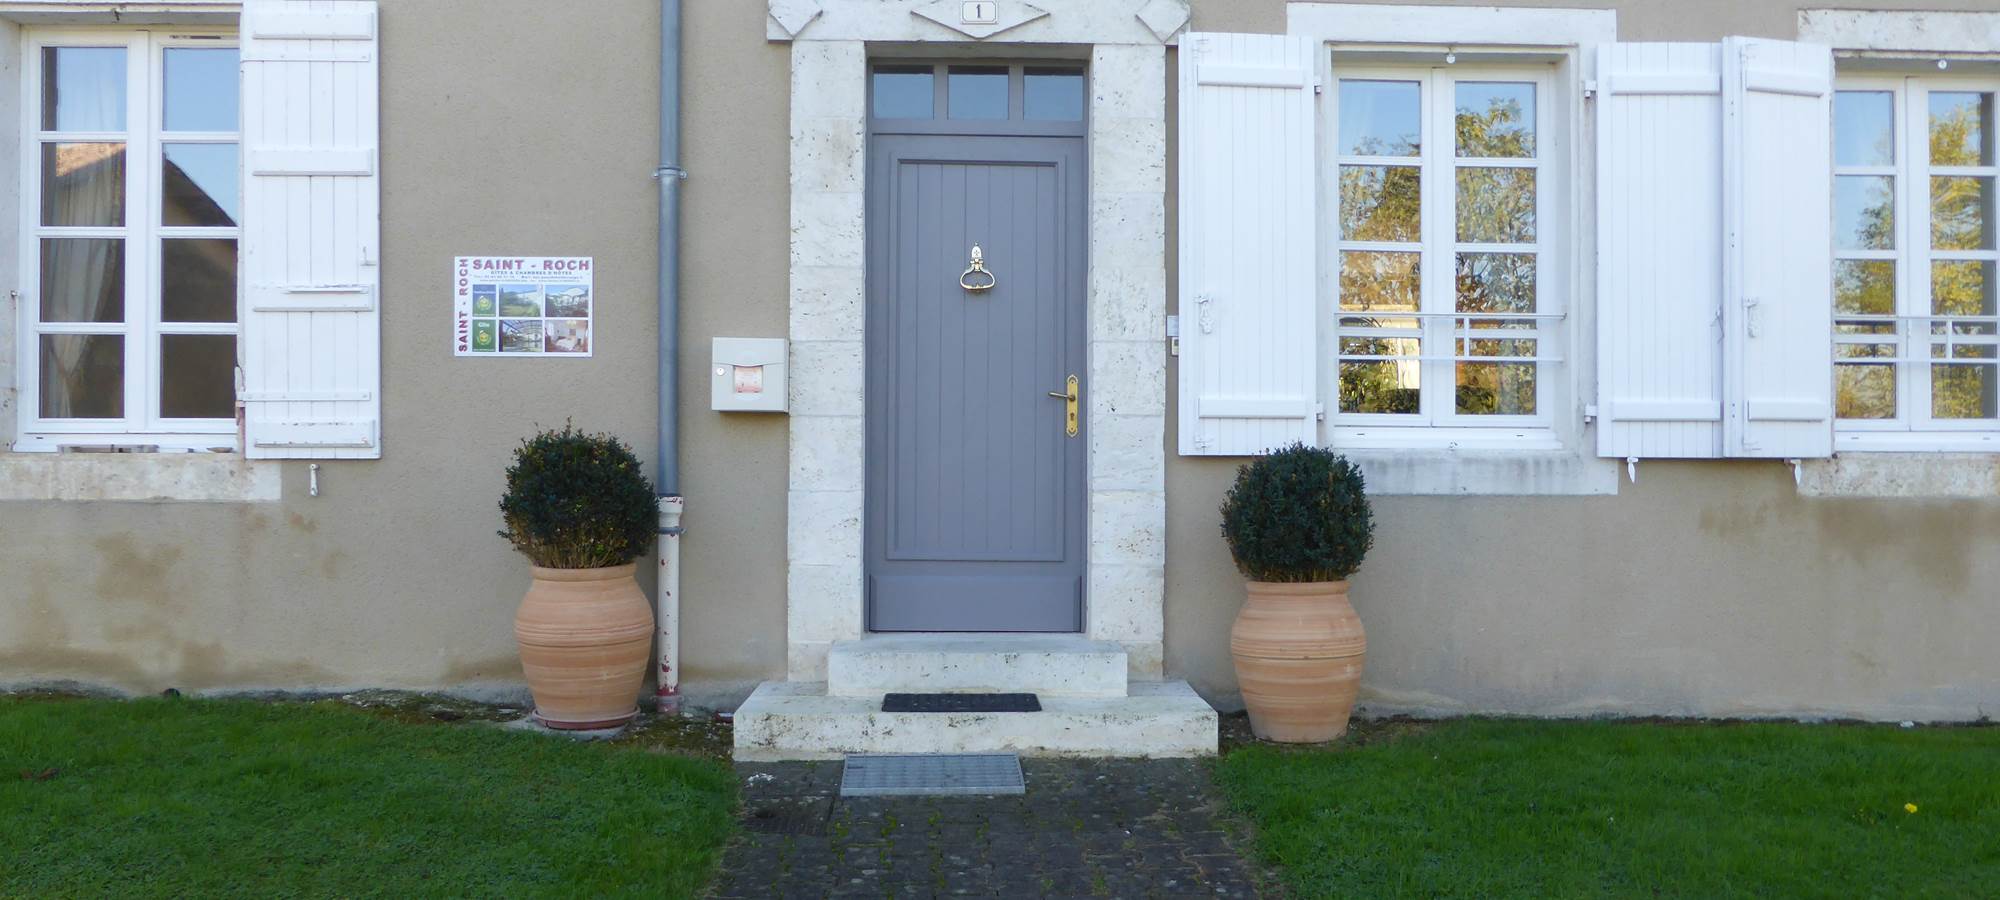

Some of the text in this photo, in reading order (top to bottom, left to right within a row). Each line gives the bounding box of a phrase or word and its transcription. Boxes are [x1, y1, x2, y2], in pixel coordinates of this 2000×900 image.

[976, 3, 981, 18] 1
[458, 258, 468, 296] ROCH
[472, 259, 525, 271] SAINT
[543, 259, 590, 271] ROCH
[458, 311, 468, 352] SAINT
